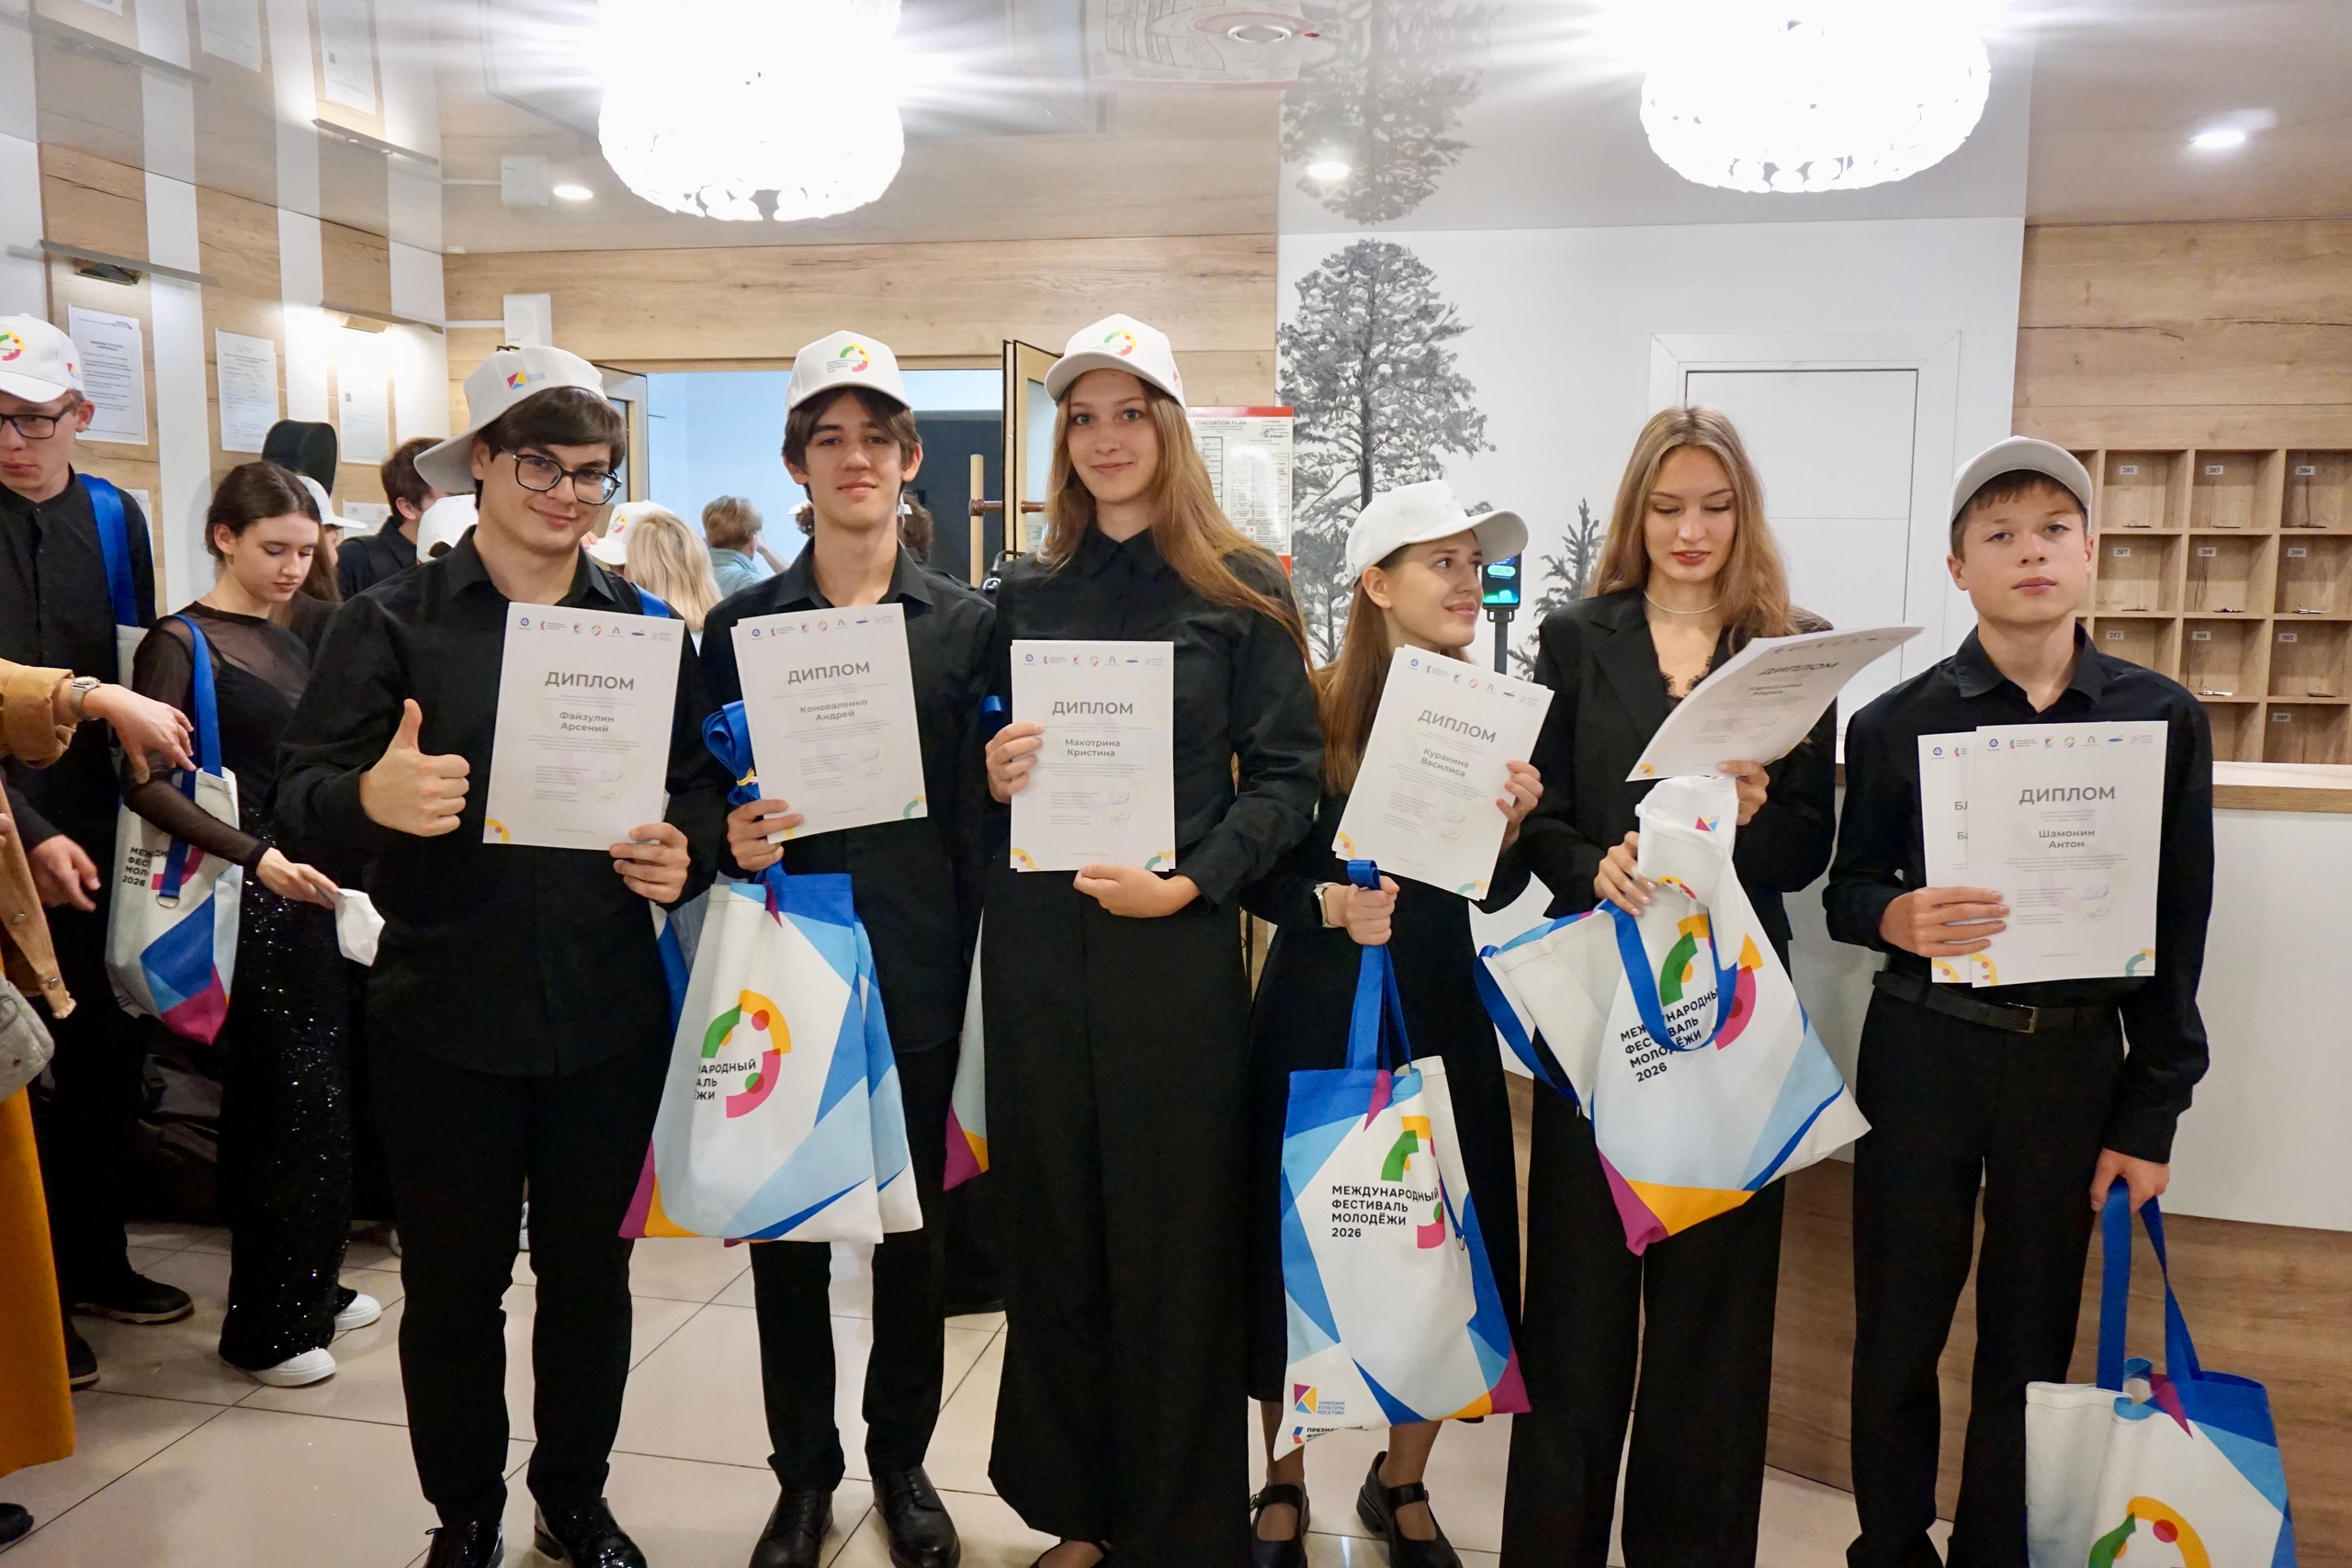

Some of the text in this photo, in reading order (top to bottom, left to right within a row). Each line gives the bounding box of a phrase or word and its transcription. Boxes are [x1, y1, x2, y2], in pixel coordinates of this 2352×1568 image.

[787, 661, 870, 685] ДИПЛОМ
[545, 671, 635, 691] ДИПЛОМ
[799, 699, 867, 714] Коноваленко
[1052, 701, 1133, 716] ДИПЛОМ
[560, 711, 615, 724] Файзулин
[815, 710, 855, 722] Андрей
[560, 721, 609, 733] Арсений
[1418, 709, 1497, 743] ДИПЛОМ
[1065, 738, 1120, 749] Макотрина
[1067, 748, 1115, 758] Кристина
[1423, 748, 1469, 769] Куракина
[1420, 757, 1465, 778] Василиса
[2018, 786, 2116, 805] ДИПЛОМ
[2038, 829, 2095, 839] Шамонин
[2048, 840, 2085, 849] Антон
[698, 1058, 756, 1075] АРОДНЫЙ
[1635, 1062, 1668, 1082] 2026
[1332, 1185, 1440, 1202] МЕЖДУНАРОДНЫЙ
[1331, 1199, 1408, 1212] ФЕСТИВАЛЬ
[1331, 1212, 1406, 1225] МОЛОДЁЖИ
[1331, 1227, 1362, 1237] 2026
